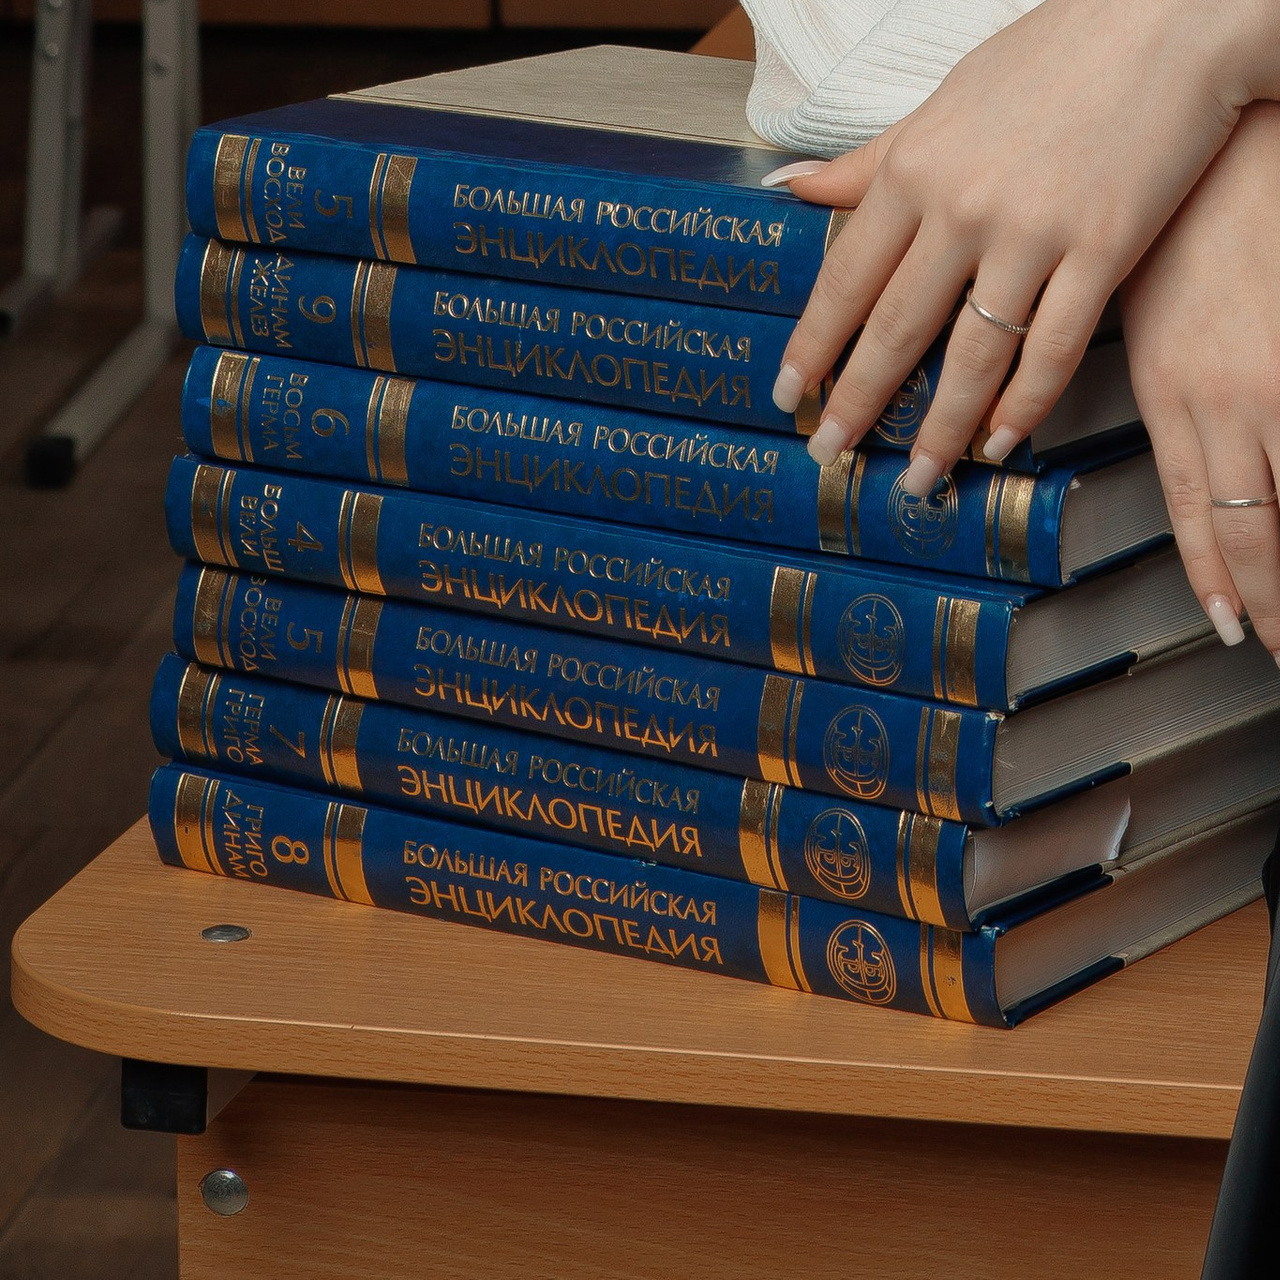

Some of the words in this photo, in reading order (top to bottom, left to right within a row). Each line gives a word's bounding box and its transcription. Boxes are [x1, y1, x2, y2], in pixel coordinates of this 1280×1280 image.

[263, 143, 291, 244] ВОСХОД
[286, 166, 307, 229] ВЕЛИ
[314, 189, 353, 219] 5
[453, 184, 585, 223] БОЛЬШАЯ
[596, 201, 783, 247] РОССИЙСКАЯ
[453, 222, 781, 294] ЭНЦИКЛОПЕДИЯ
[250, 259, 273, 337] ЖЕЛЕЗ
[271, 252, 295, 348] ДИНАМ
[298, 295, 336, 324] 9
[433, 291, 560, 333] БОЛЬШАЯ
[571, 311, 751, 362] РОССИЙСКАЯ
[433, 328, 751, 409] ЭНЦИКЛОПЕДИЯ
[261, 374, 285, 450] ГЕРМА
[283, 372, 309, 459] ВОСЬМ
[311, 407, 350, 437] 6
[451, 404, 583, 447] БОЛЬШАЯ
[593, 425, 779, 475] РОССИЙСКАЯ
[450, 443, 774, 523] ЭНЦИКЛОПЕДИЯ
[239, 495, 260, 557] ВЕЛИ
[260, 484, 285, 573] БОЛЬШ
[287, 521, 324, 552] 4
[419, 523, 543, 568] БОЛЬШАЯ
[554, 547, 731, 600] РОССИЙСКАЯ
[261, 597, 283, 661] ВЕЛИ
[286, 621, 324, 653] 5
[419, 560, 731, 647] ЭНЦИКЛОПЕДИЯ
[416, 626, 538, 673] БОЛЬШАЯ
[548, 653, 721, 712] РОССИЙСКАЯ
[224, 689, 245, 763] ГРИГО
[243, 694, 264, 765] ГЕРМА
[269, 724, 306, 759] 7
[414, 664, 718, 757] ЭНЦИКЛОПЕДИЯ
[397, 728, 519, 776] БОЛЬШАЯ
[529, 755, 701, 814] РОССИЙСКАЯ
[222, 789, 251, 879] ДИНАМ
[244, 804, 268, 878] ГРИГО
[397, 765, 702, 857] ЭНЦИКЛОПЕДИЯ
[271, 835, 310, 865] 8
[403, 840, 528, 887] БОЛЬШАЯ
[540, 867, 717, 926] РОССИЙСКАЯ
[405, 876, 724, 965] ЭНЦИКЛОПЕДИЯ
